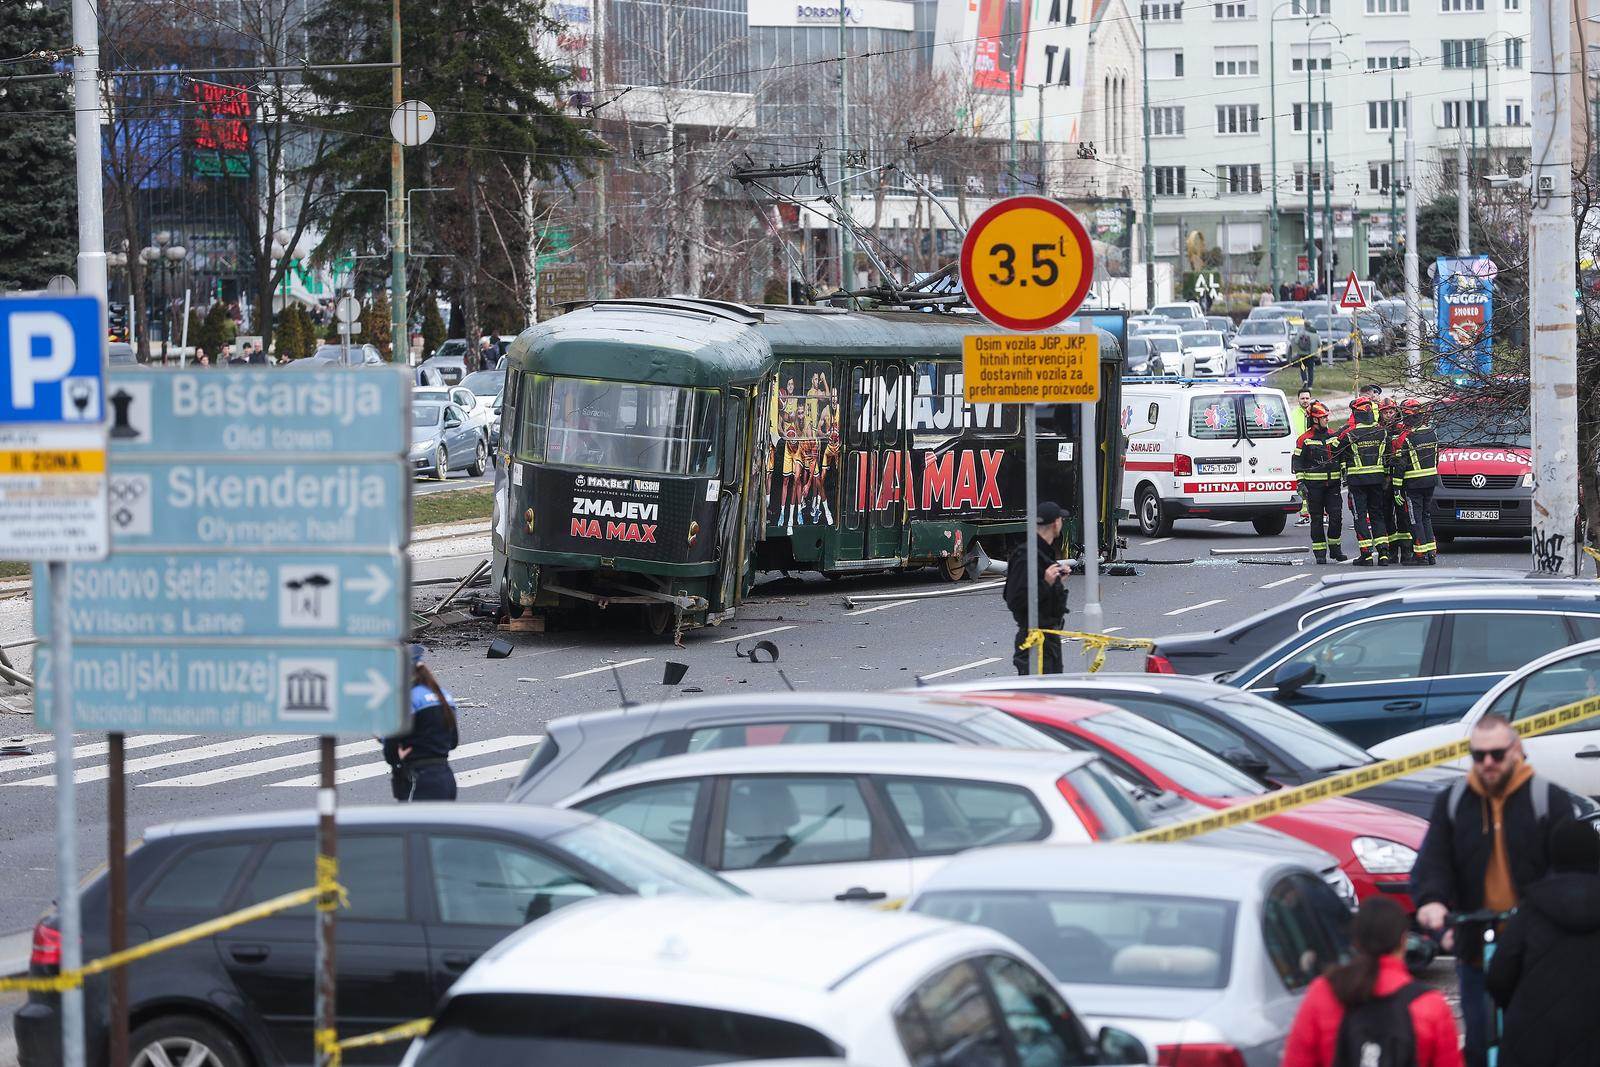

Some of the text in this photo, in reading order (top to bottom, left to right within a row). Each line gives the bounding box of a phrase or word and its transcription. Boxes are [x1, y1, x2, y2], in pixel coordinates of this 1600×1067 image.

[1454, 307, 1479, 316] SMOKED
[976, 337, 1002, 351] Osim
[1006, 337, 1036, 350] vozila
[8, 310, 77, 409] P
[980, 353, 1010, 366] hitnih
[1013, 353, 1077, 368] intervencija
[980, 368, 1083, 381] dostavnih vozila za
[171, 372, 382, 426] Baščaršija
[969, 383, 1095, 399] prehrambene proizvode
[222, 425, 266, 449] Old
[1130, 442, 1161, 453] SARAJEVO
[1202, 463, 1236, 472] K75-T-679
[922, 449, 1005, 510] MAX
[1198, 481, 1292, 492] HITNA POMOC
[167, 465, 386, 517] Skenderija
[572, 497, 659, 520] ZMAJEVI
[1460, 511, 1499, 520] A68-J-403
[570, 518, 657, 543] NA MAX
[183, 609, 245, 633] Lane
[38, 652, 278, 700] Zmaljski muzej
